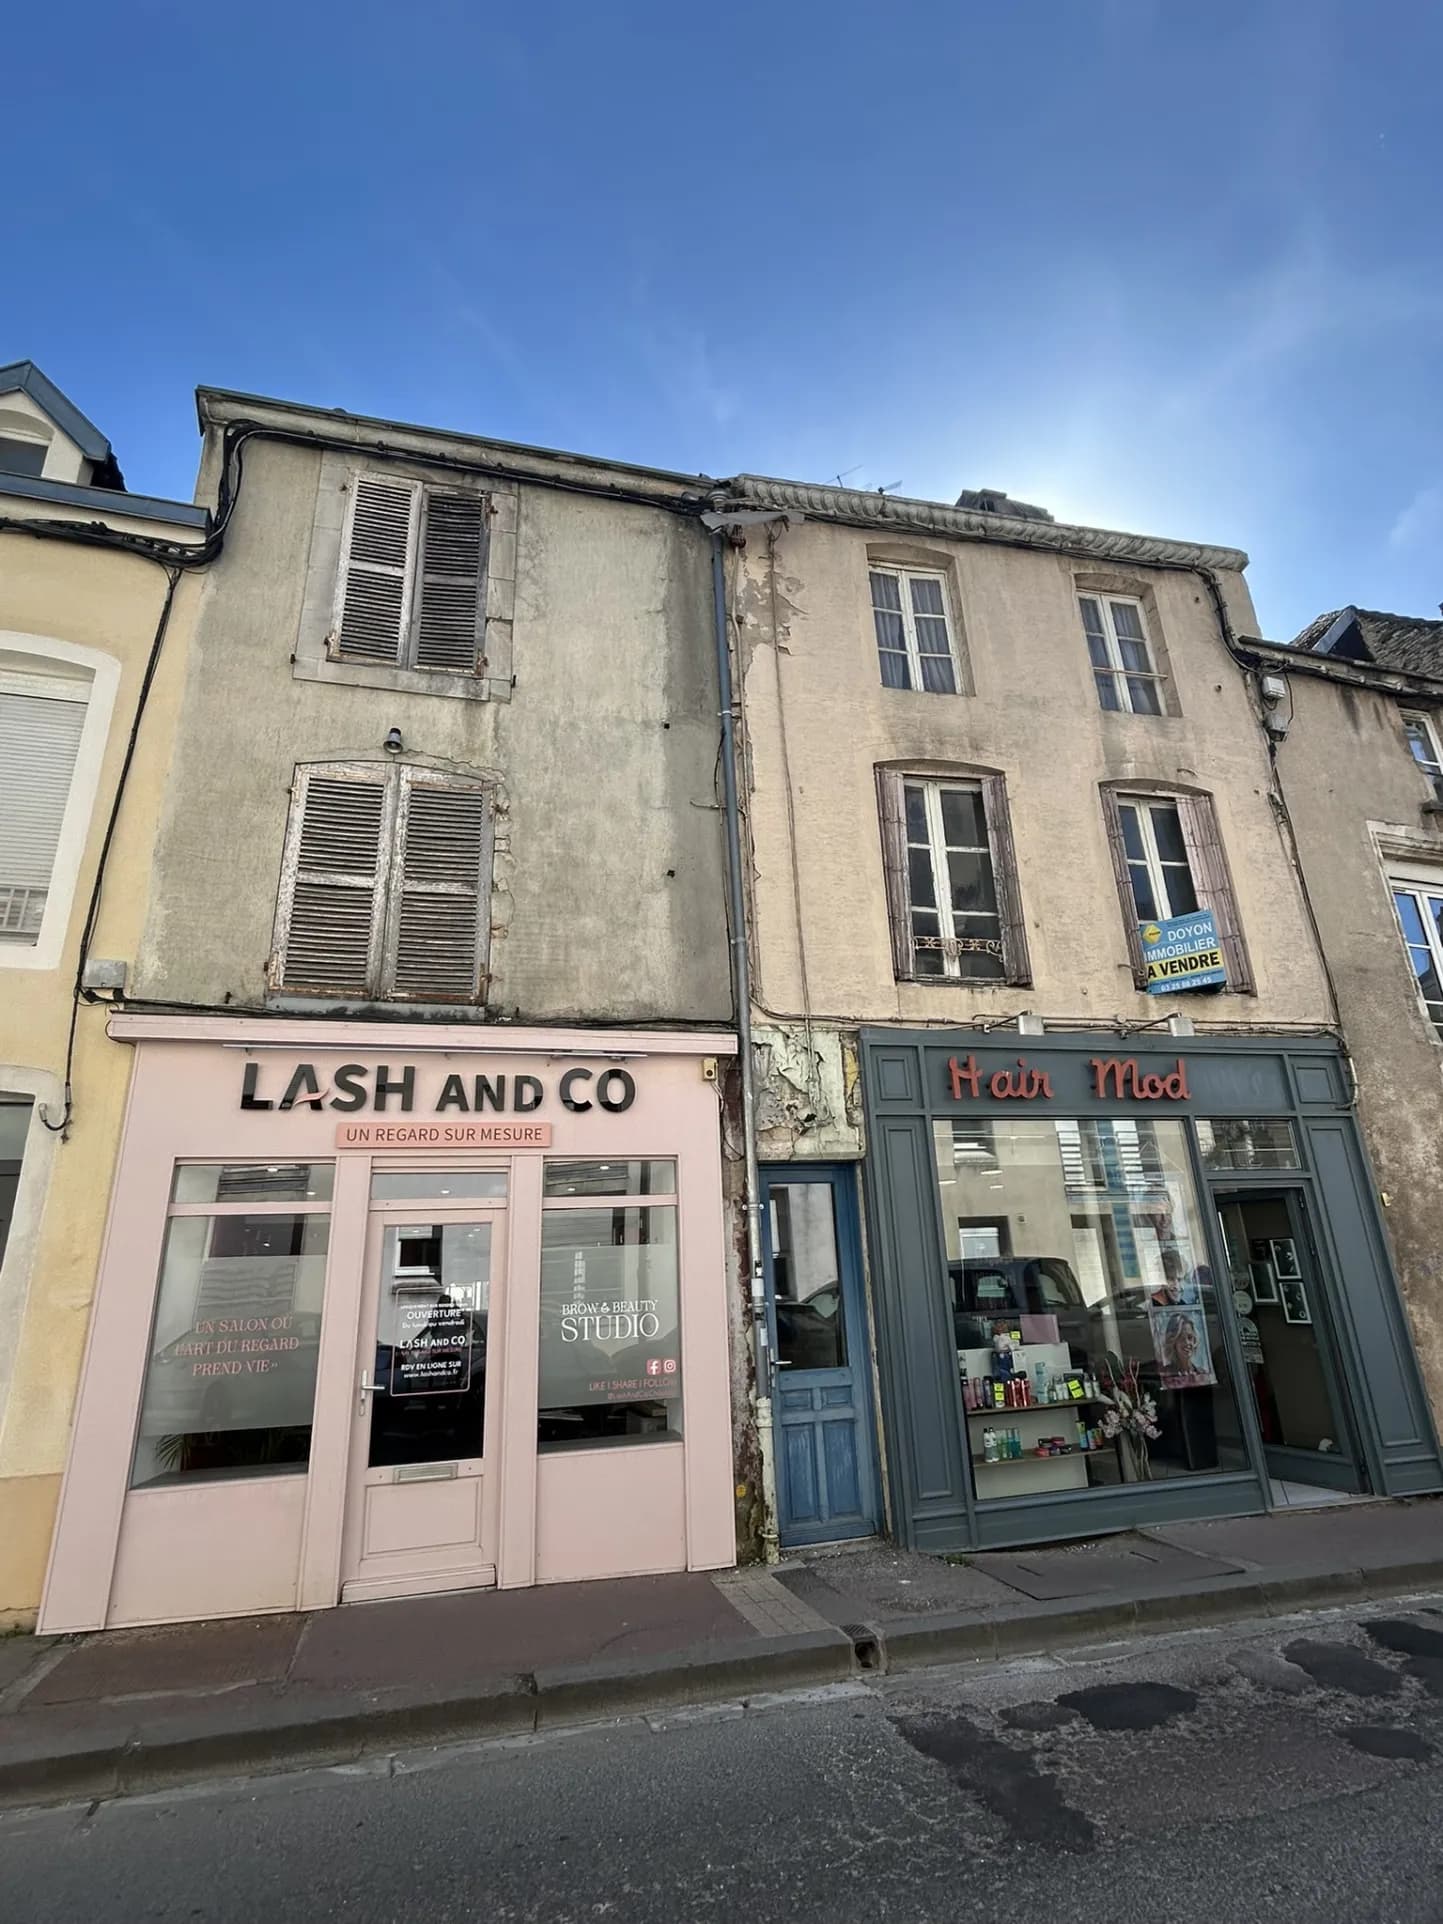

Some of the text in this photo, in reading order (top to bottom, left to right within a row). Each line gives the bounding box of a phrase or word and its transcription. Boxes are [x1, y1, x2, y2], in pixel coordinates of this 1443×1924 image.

[1167, 921, 1213, 942] DOYON
[1144, 936, 1217, 963] IMMOBILIER
[1147, 965, 1157, 979] A
[1158, 951, 1220, 976] VENDRE
[948, 1054, 1055, 1100] Hair
[1090, 1056, 1191, 1100] Mod
[240, 1062, 636, 1113] LASH AND CO
[346, 1127, 543, 1142] UN REGARD SUR MESURE
[407, 1309, 461, 1320] OUVERTURE
[562, 1299, 659, 1315] BROW & BEAUTY
[195, 1320, 214, 1334] UN
[218, 1317, 268, 1332] SALON
[561, 1312, 660, 1342] STUDIO
[216, 1340, 238, 1354] DU
[241, 1337, 299, 1352] REGARD
[399, 1339, 428, 1349] LASH
[451, 1336, 466, 1345] CO
[192, 1361, 242, 1376] PREND
[612, 1379, 638, 1390] SHARE
